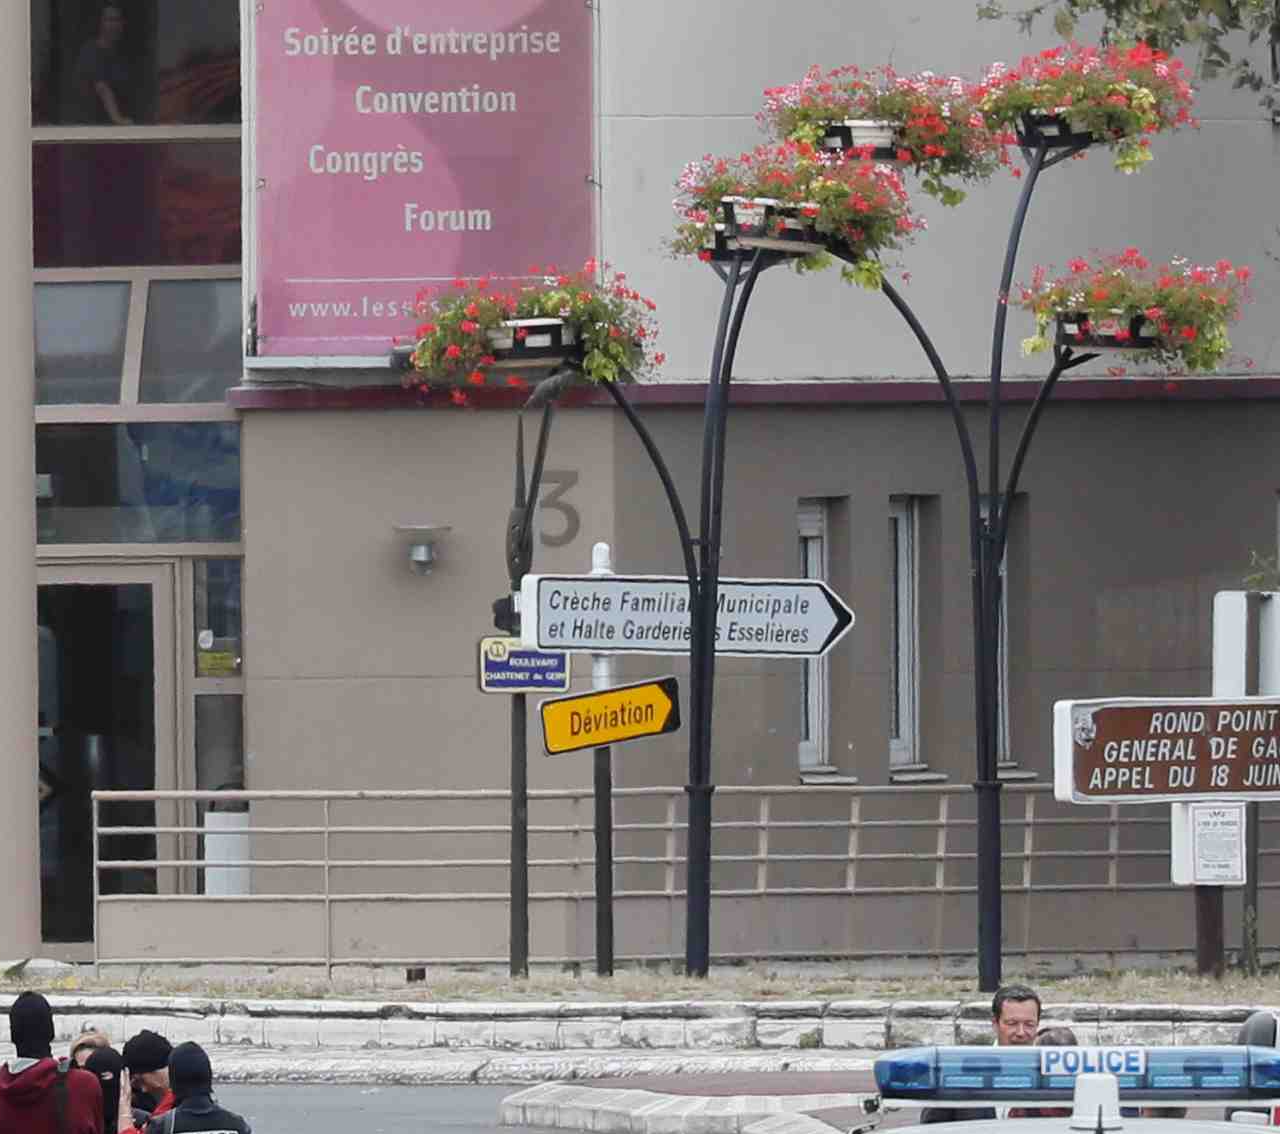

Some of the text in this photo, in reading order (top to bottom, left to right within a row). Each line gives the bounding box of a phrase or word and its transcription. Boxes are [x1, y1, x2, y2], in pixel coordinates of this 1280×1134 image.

[284, 25, 561, 61] Soirée d'entreprise
[355, 84, 517, 114] Convention
[308, 144, 423, 181] Congrès
[403, 201, 492, 231] Forum
[539, 469, 581, 548] 3
[548, 590, 611, 612] Crèche
[620, 592, 691, 614] Familia
[548, 620, 566, 638] et
[572, 620, 615, 640] Halte
[622, 620, 691, 641] Garderie
[728, 622, 809, 644] Esselières
[570, 702, 655, 737] Déviation
[1149, 709, 1278, 734] ROND POINT
[1104, 738, 1196, 763] GENERAL
[1210, 736, 1237, 760] DE
[1089, 766, 1154, 789] APPEL
[1168, 765, 1196, 787] DU
[1210, 764, 1230, 787] 18
[1045, 1050, 1141, 1073] POLICE
